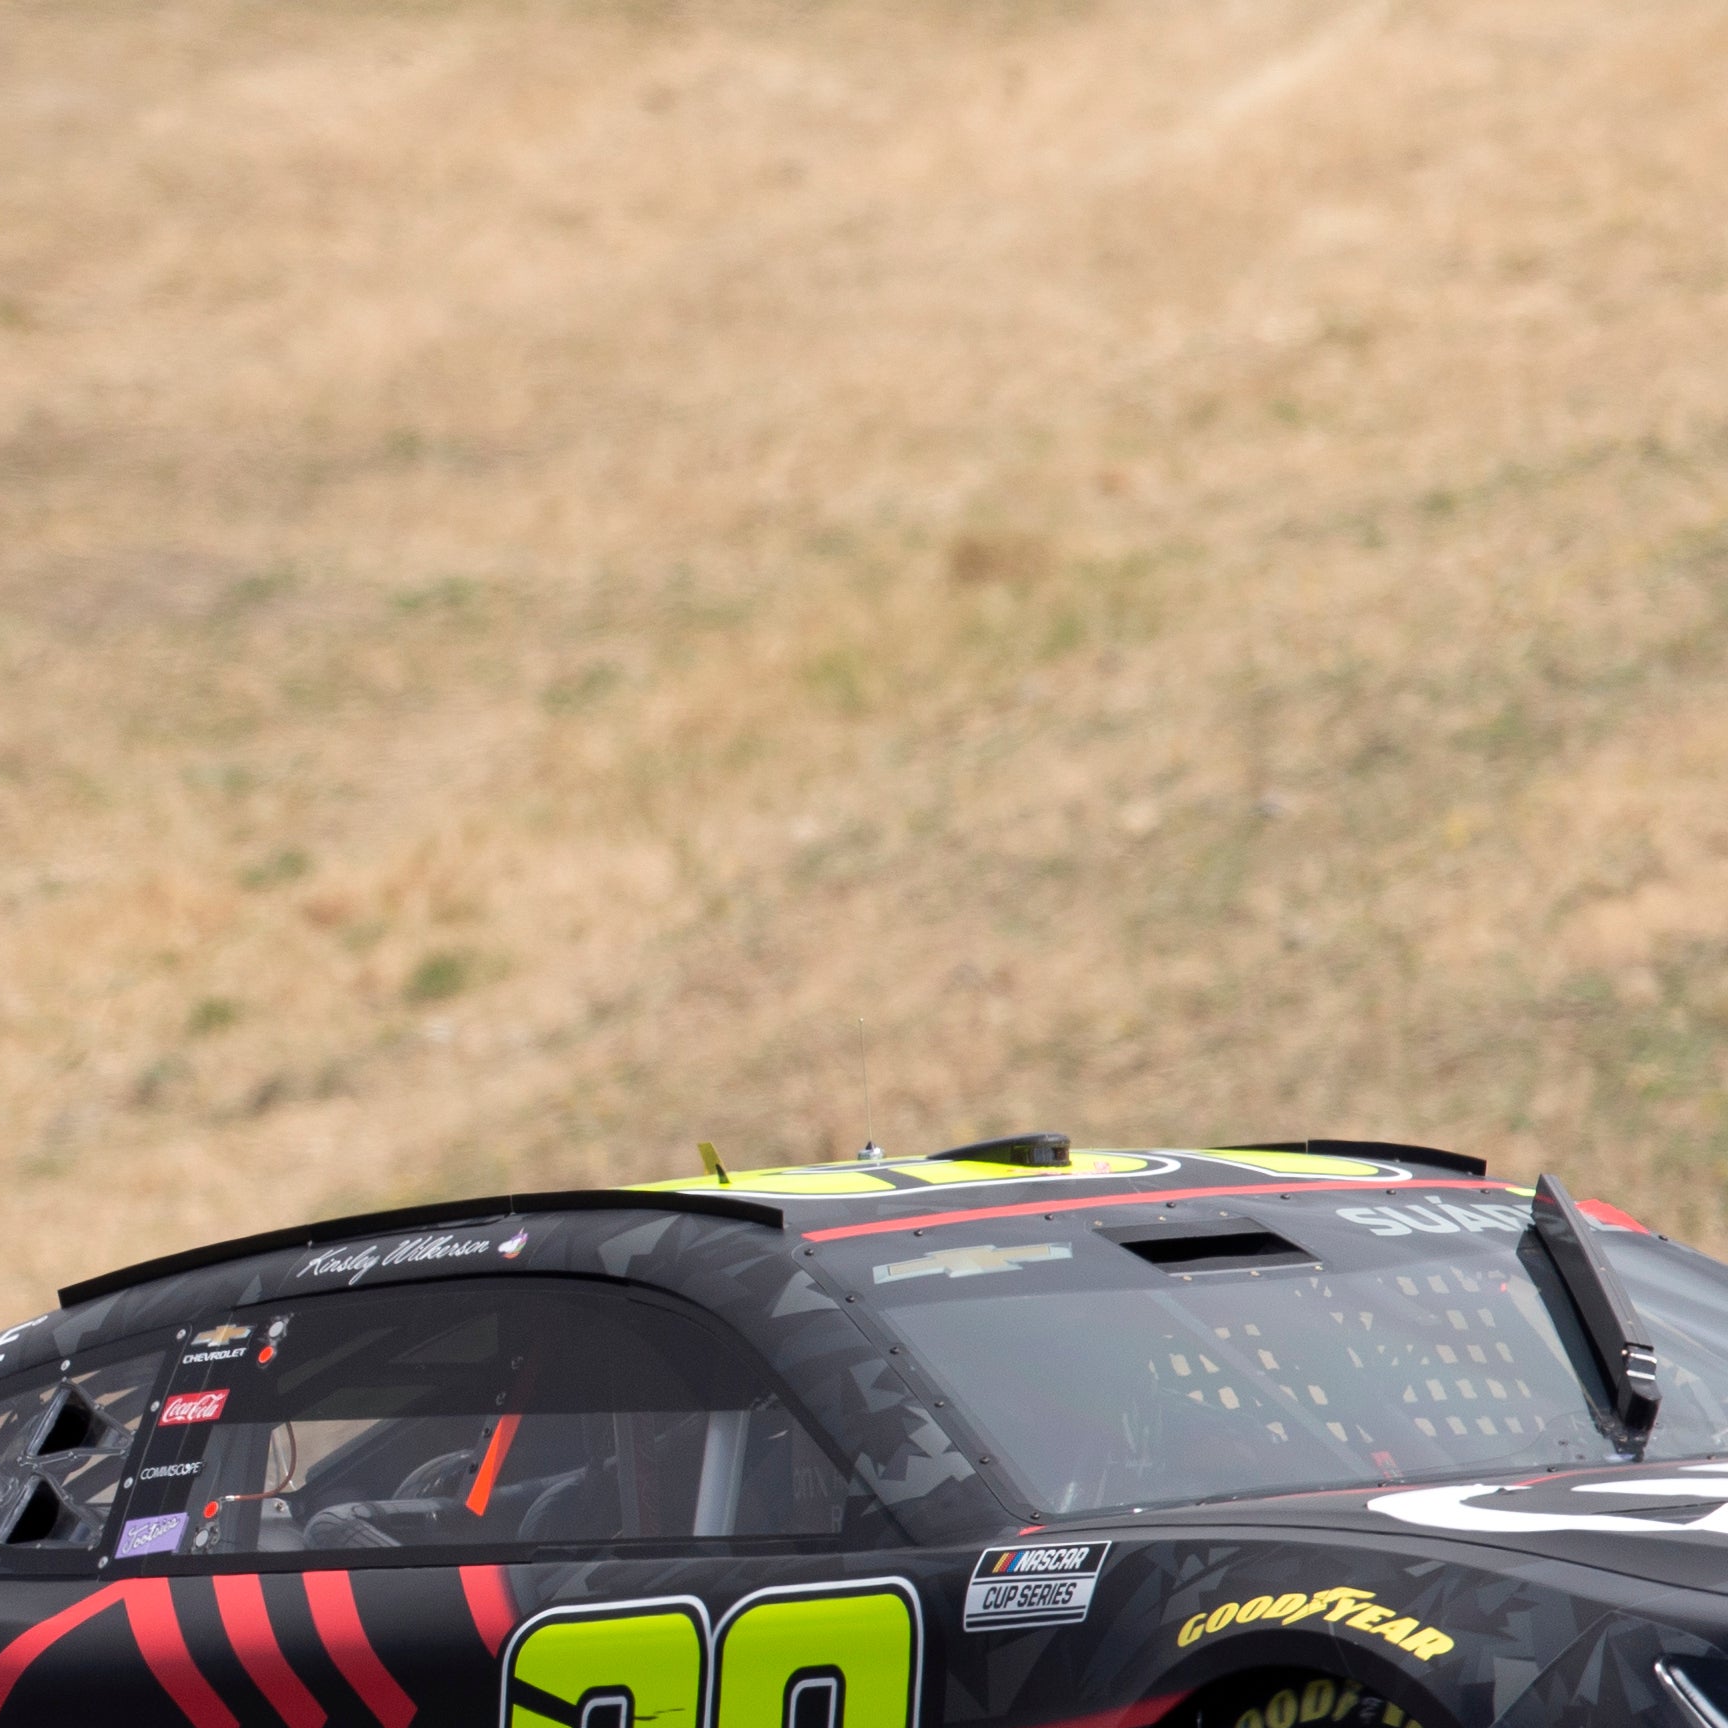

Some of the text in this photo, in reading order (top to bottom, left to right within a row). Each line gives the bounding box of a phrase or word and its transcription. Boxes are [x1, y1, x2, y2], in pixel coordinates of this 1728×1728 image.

[296, 1234, 491, 1286] Kinsley Wilkerson
[182, 1347, 248, 1365] CHEVROLET
[139, 1460, 203, 1482] COMMSCOPE
[1013, 1546, 1090, 1573] NASCAR
[982, 1582, 1078, 1611] CUP SERIES
[1175, 1584, 1457, 1663] GOODYEAR
